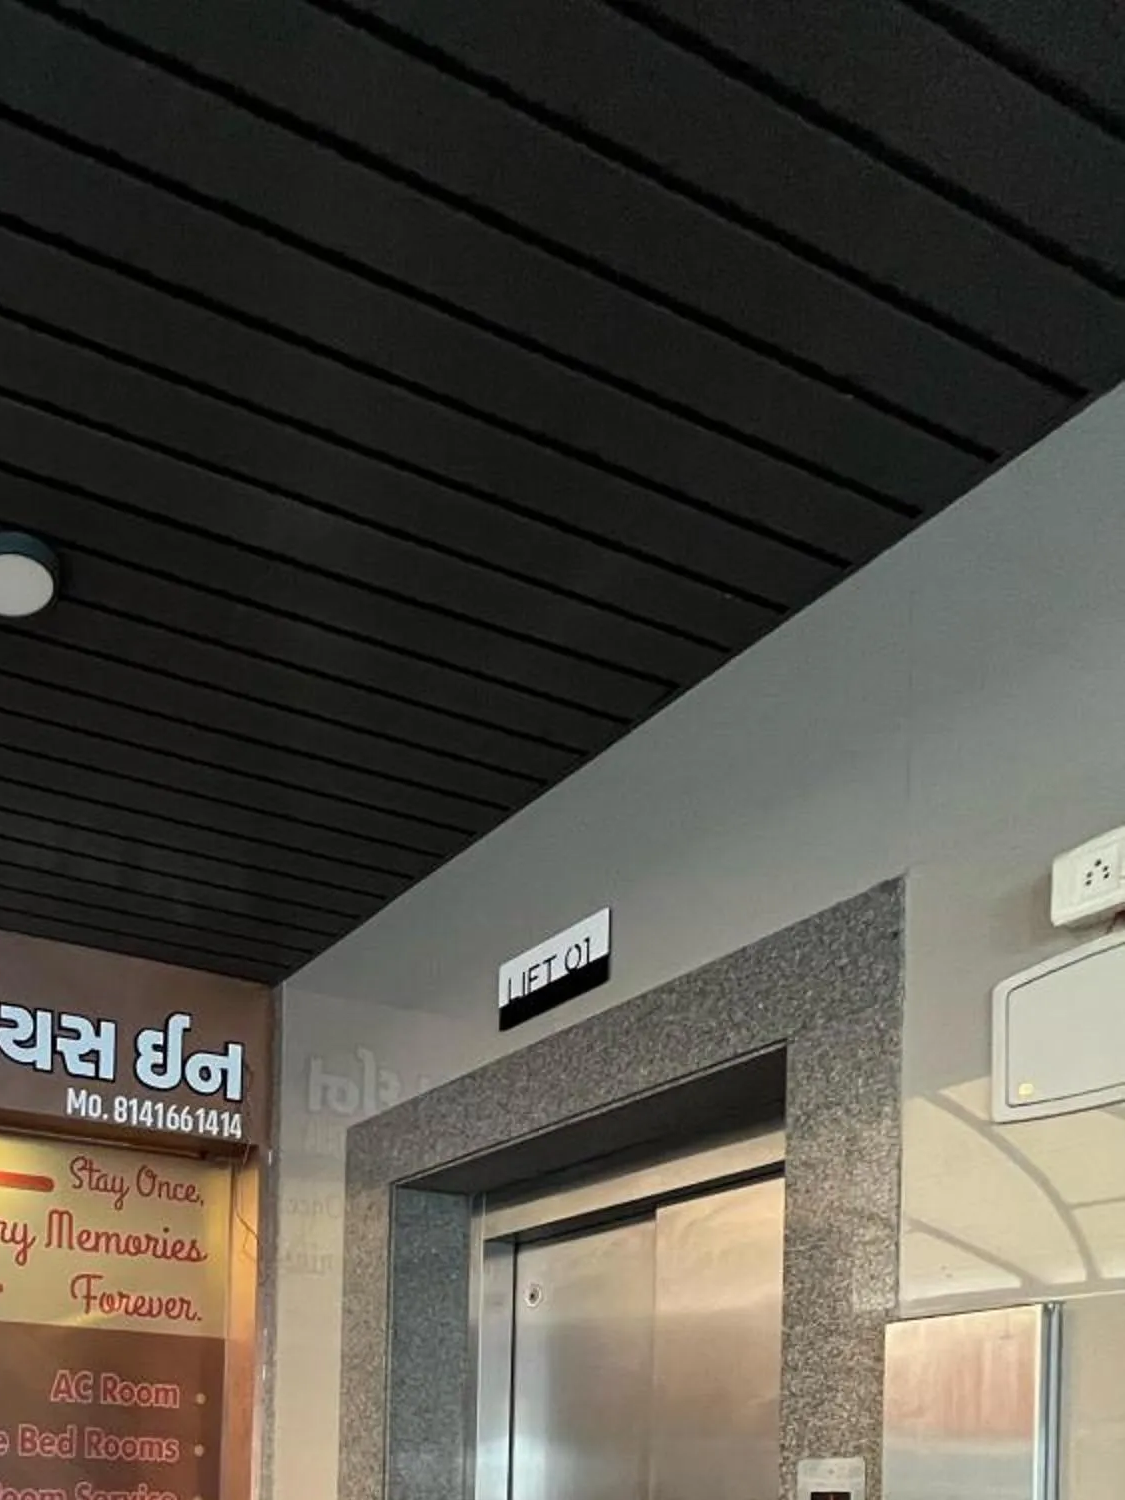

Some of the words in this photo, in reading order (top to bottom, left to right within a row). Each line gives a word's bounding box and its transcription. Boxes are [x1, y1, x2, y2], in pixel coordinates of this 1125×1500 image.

[507, 953, 558, 1004] LIFT
[134, 1012, 245, 1103] ઈન
[113, 1095, 243, 1140] 8141661414
[70, 1155, 129, 1210] Stay
[136, 1164, 204, 1206] Once,
[44, 1207, 208, 1263] Memories
[70, 1273, 202, 1321] Forever.
[51, 1369, 93, 1404] AC
[100, 1372, 179, 1409] Room
[18, 1422, 75, 1459] Bed
[84, 1428, 179, 1463] Rooms
